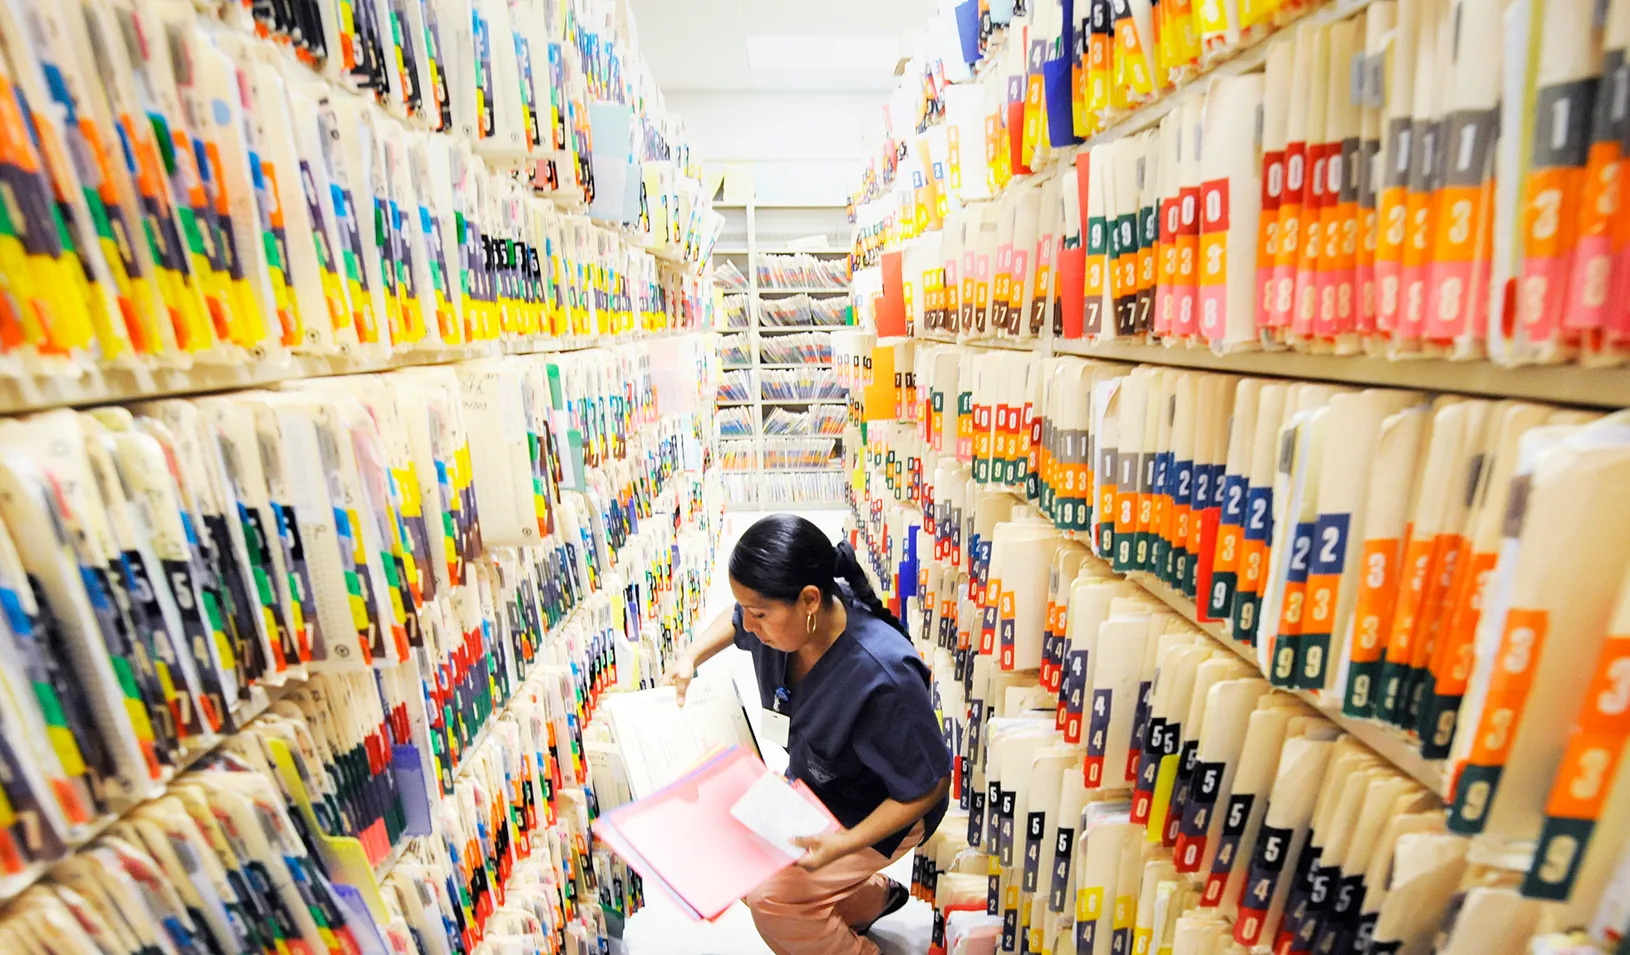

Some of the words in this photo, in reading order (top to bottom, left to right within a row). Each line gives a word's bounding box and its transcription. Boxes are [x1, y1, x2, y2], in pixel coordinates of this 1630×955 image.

[1551, 98, 1569, 148] 1
[1457, 125, 1476, 170] 1
[1288, 155, 1302, 189] 0
[1182, 196, 1194, 224] 0
[1207, 190, 1220, 222] 0
[1533, 190, 1561, 239] 3
[1387, 205, 1406, 244] 3
[1449, 200, 1471, 243] 3
[1092, 224, 1101, 248] 9
[1283, 218, 1298, 252] 3
[1121, 222, 1131, 246] 9
[1126, 263, 1135, 286] 3
[1181, 248, 1191, 274] 3
[1090, 264, 1100, 287] 3
[978, 312, 983, 328] 7
[1088, 303, 1098, 326] 7
[1180, 296, 1191, 323] 8
[1205, 298, 1216, 327] 8
[981, 410, 988, 426] 0
[999, 410, 1005, 426] 0
[1010, 412, 1016, 428] 0
[1033, 424, 1040, 441] 0
[1067, 436, 1071, 455] 1
[1082, 437, 1086, 456] 1
[1105, 455, 1111, 476] 1
[1124, 460, 1129, 483] 1
[1066, 470, 1073, 489] 3
[1079, 472, 1086, 490] 3
[1179, 470, 1190, 495] 2
[1197, 474, 1208, 500] 2
[1104, 494, 1112, 513] 3
[1228, 485, 1241, 514] 2
[1065, 504, 1072, 522] 9
[1078, 505, 1085, 524] 9
[1122, 501, 1130, 523] 3
[1250, 498, 1266, 529] 2
[1103, 530, 1111, 550] 9
[1223, 534, 1235, 559] 3
[1320, 527, 1339, 562] 2
[1120, 541, 1129, 563] 9
[1137, 541, 1147, 563] 9
[1289, 534, 1310, 570] 2
[1247, 552, 1260, 580] 3
[1367, 553, 1385, 587] 3
[1213, 582, 1226, 608] 9
[1313, 589, 1330, 620] 3
[987, 608, 994, 624] 4
[1240, 603, 1253, 630] 9
[1283, 592, 1303, 623] 3
[1058, 612, 1066, 628] 3
[984, 634, 991, 650] 0
[1361, 616, 1378, 648] 3
[1005, 651, 1011, 665] 0
[1055, 642, 1062, 658] 4
[1072, 657, 1082, 676] 4
[1276, 647, 1292, 678] 9
[1305, 646, 1322, 678] 9
[1051, 671, 1059, 687] 0
[1071, 689, 1080, 707] 4
[1352, 675, 1370, 707] 9
[1094, 696, 1105, 716] 4
[1069, 720, 1077, 737] 0
[1152, 726, 1163, 747] 5
[1092, 730, 1102, 749] 4
[1164, 733, 1173, 753] 5
[1089, 763, 1098, 781] 0
[1144, 763, 1155, 783] 4
[1202, 770, 1217, 793] 5
[990, 787, 997, 802] 5
[1003, 796, 1011, 813] 5
[1136, 799, 1148, 817] 0
[1194, 808, 1207, 829] 4
[1229, 803, 1244, 827] 5
[1032, 818, 1039, 834] 5
[1029, 845, 1036, 860] 4
[1059, 834, 1067, 851] 5
[1265, 837, 1281, 861] 5
[1184, 845, 1197, 865] 0
[1218, 843, 1232, 864] 4
[1028, 872, 1033, 887] 1
[1057, 862, 1066, 878] 4
[1056, 891, 1060, 906] 1
[1206, 880, 1221, 900] 0
[1253, 879, 1270, 901] 4
[1311, 876, 1329, 903] 5
[1089, 894, 1096, 912] 6
[1083, 925, 1091, 942] 4
[1242, 917, 1258, 939] 0
